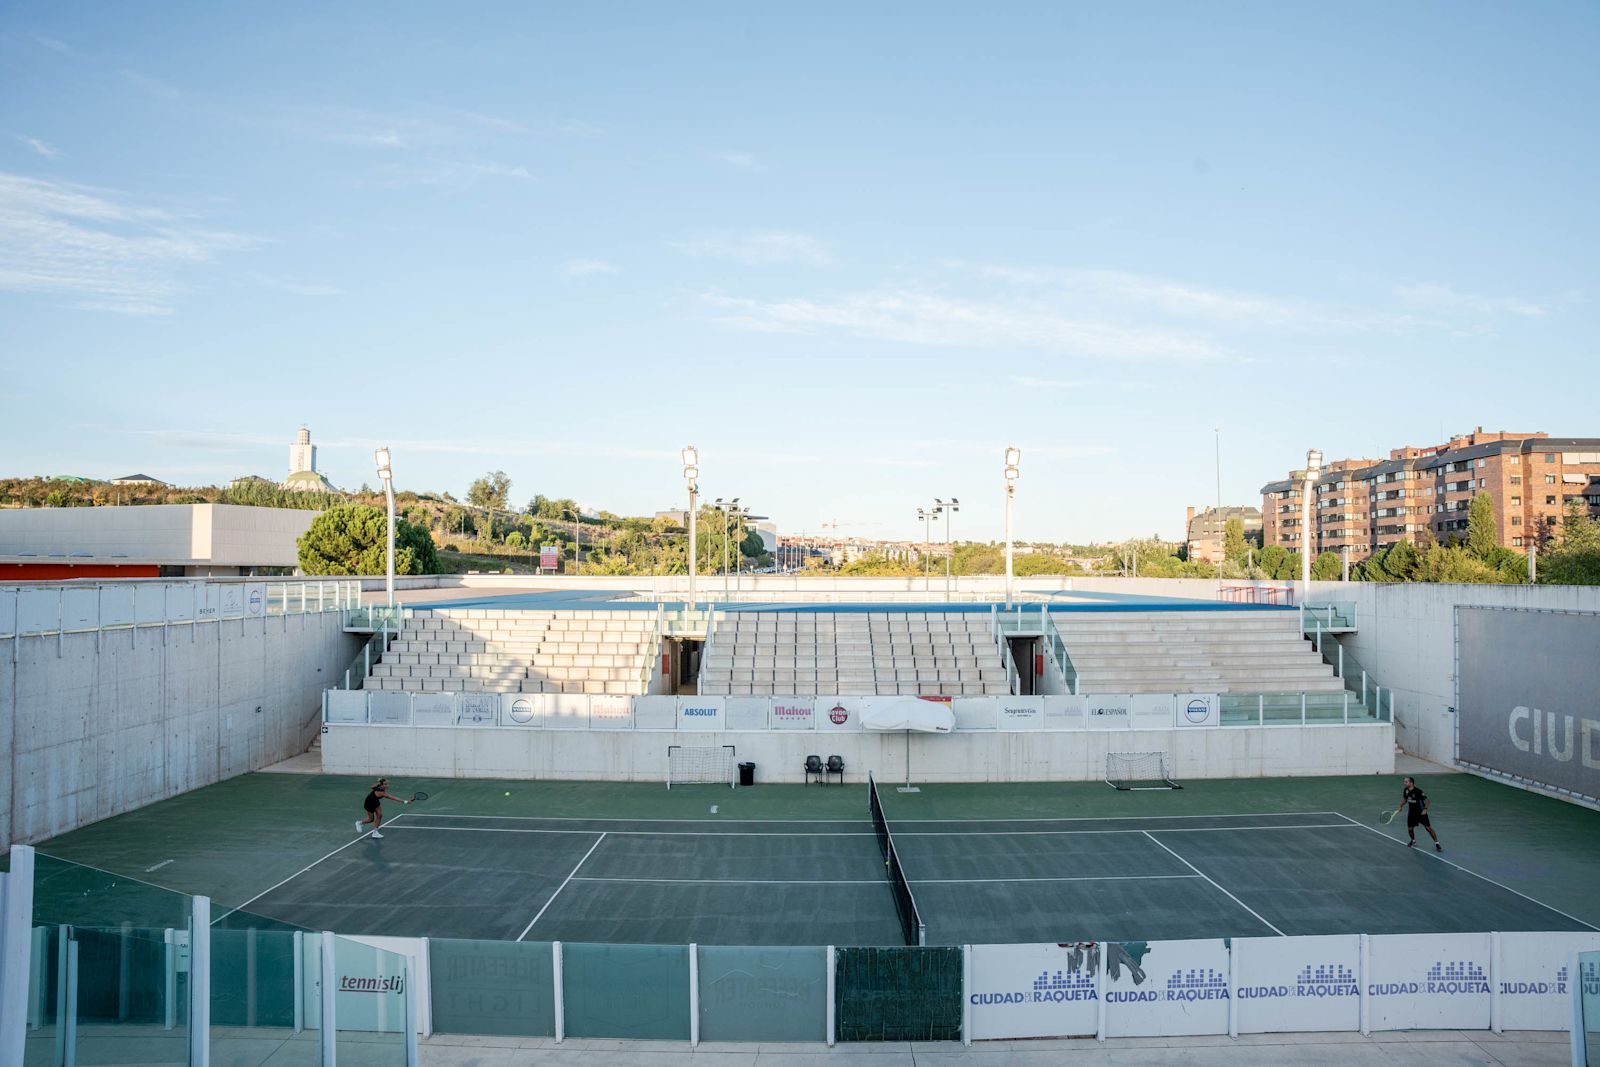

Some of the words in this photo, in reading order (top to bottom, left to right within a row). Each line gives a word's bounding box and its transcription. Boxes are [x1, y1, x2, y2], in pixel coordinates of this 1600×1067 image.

[684, 708, 717, 716] ABSOLUT
[774, 706, 811, 716] Mahou
[1105, 991, 1158, 1003] CIUDAD
[1167, 989, 1230, 1002] RAQUETA
[1237, 986, 1288, 999] CIUDAD
[1297, 985, 1360, 998] RAQUETA
[1368, 983, 1419, 996] CIUDAD
[1427, 982, 1491, 995] RAQUETA
[970, 992, 1024, 1005] CIUDAD
[1033, 989, 1098, 1003] RAQUETA
